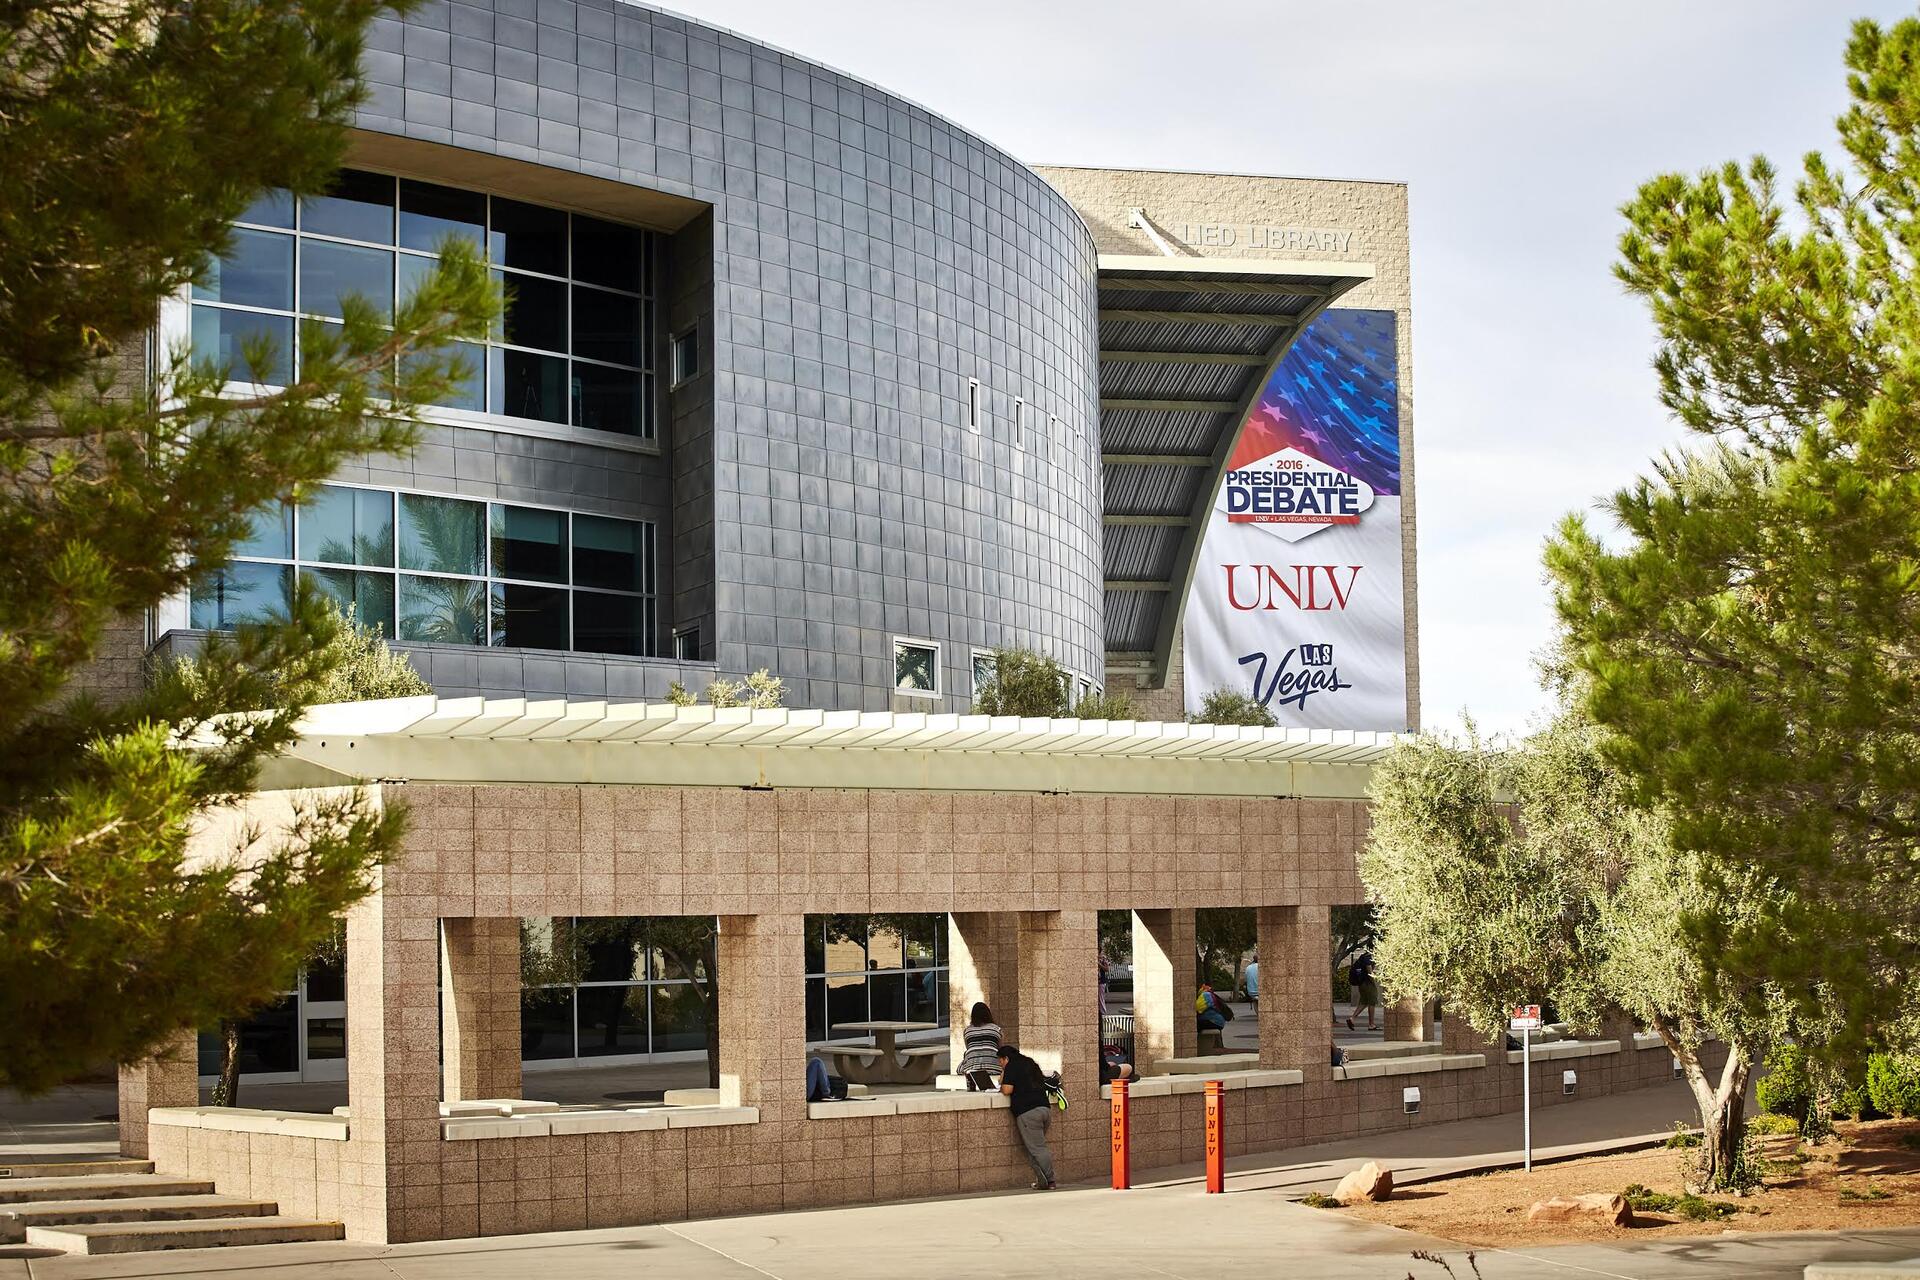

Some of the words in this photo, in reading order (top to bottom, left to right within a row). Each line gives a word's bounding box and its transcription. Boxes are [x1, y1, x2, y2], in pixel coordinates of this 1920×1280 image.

[1183, 224, 1237, 247] LIED
[1248, 226, 1353, 252] LIBRARY
[1226, 470, 1358, 487] PRESIDENTIAL
[1276, 460, 1303, 470] 2016
[1227, 486, 1360, 514] DEBATE
[1220, 564, 1364, 611] UNLV
[1302, 645, 1331, 665] LAS
[1238, 648, 1352, 711] Vegas
[1113, 1104, 1122, 1153] UNLV
[1208, 1106, 1216, 1156] UNLV
